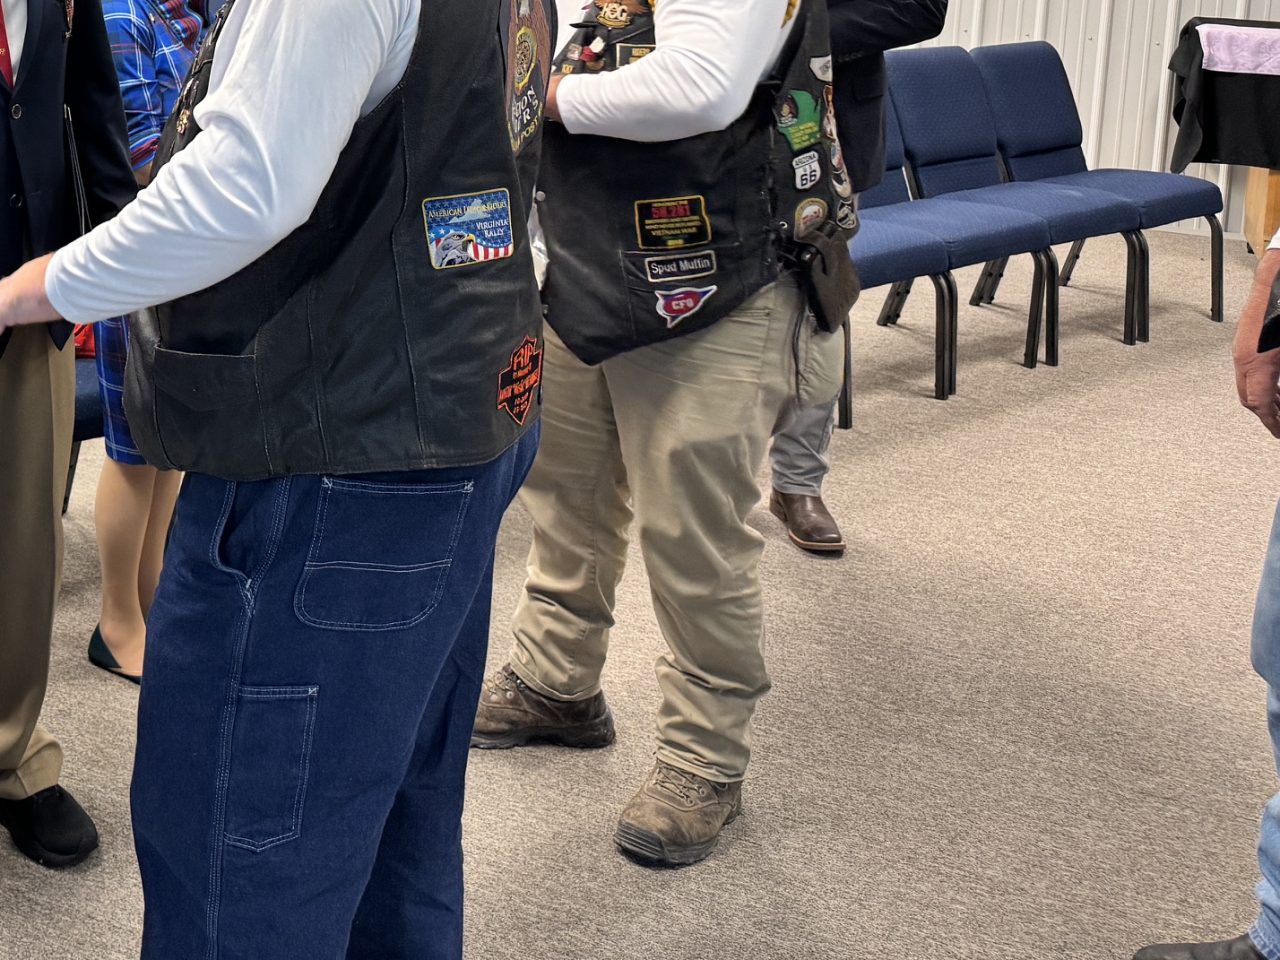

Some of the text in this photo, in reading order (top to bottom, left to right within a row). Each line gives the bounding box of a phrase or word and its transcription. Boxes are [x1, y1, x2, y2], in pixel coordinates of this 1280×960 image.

[800, 170, 817, 187] 66
[429, 207, 462, 218] AMERICAN
[476, 219, 508, 230] VIRGINIA
[484, 228, 504, 238] RALLY
[651, 262, 677, 275] Spud
